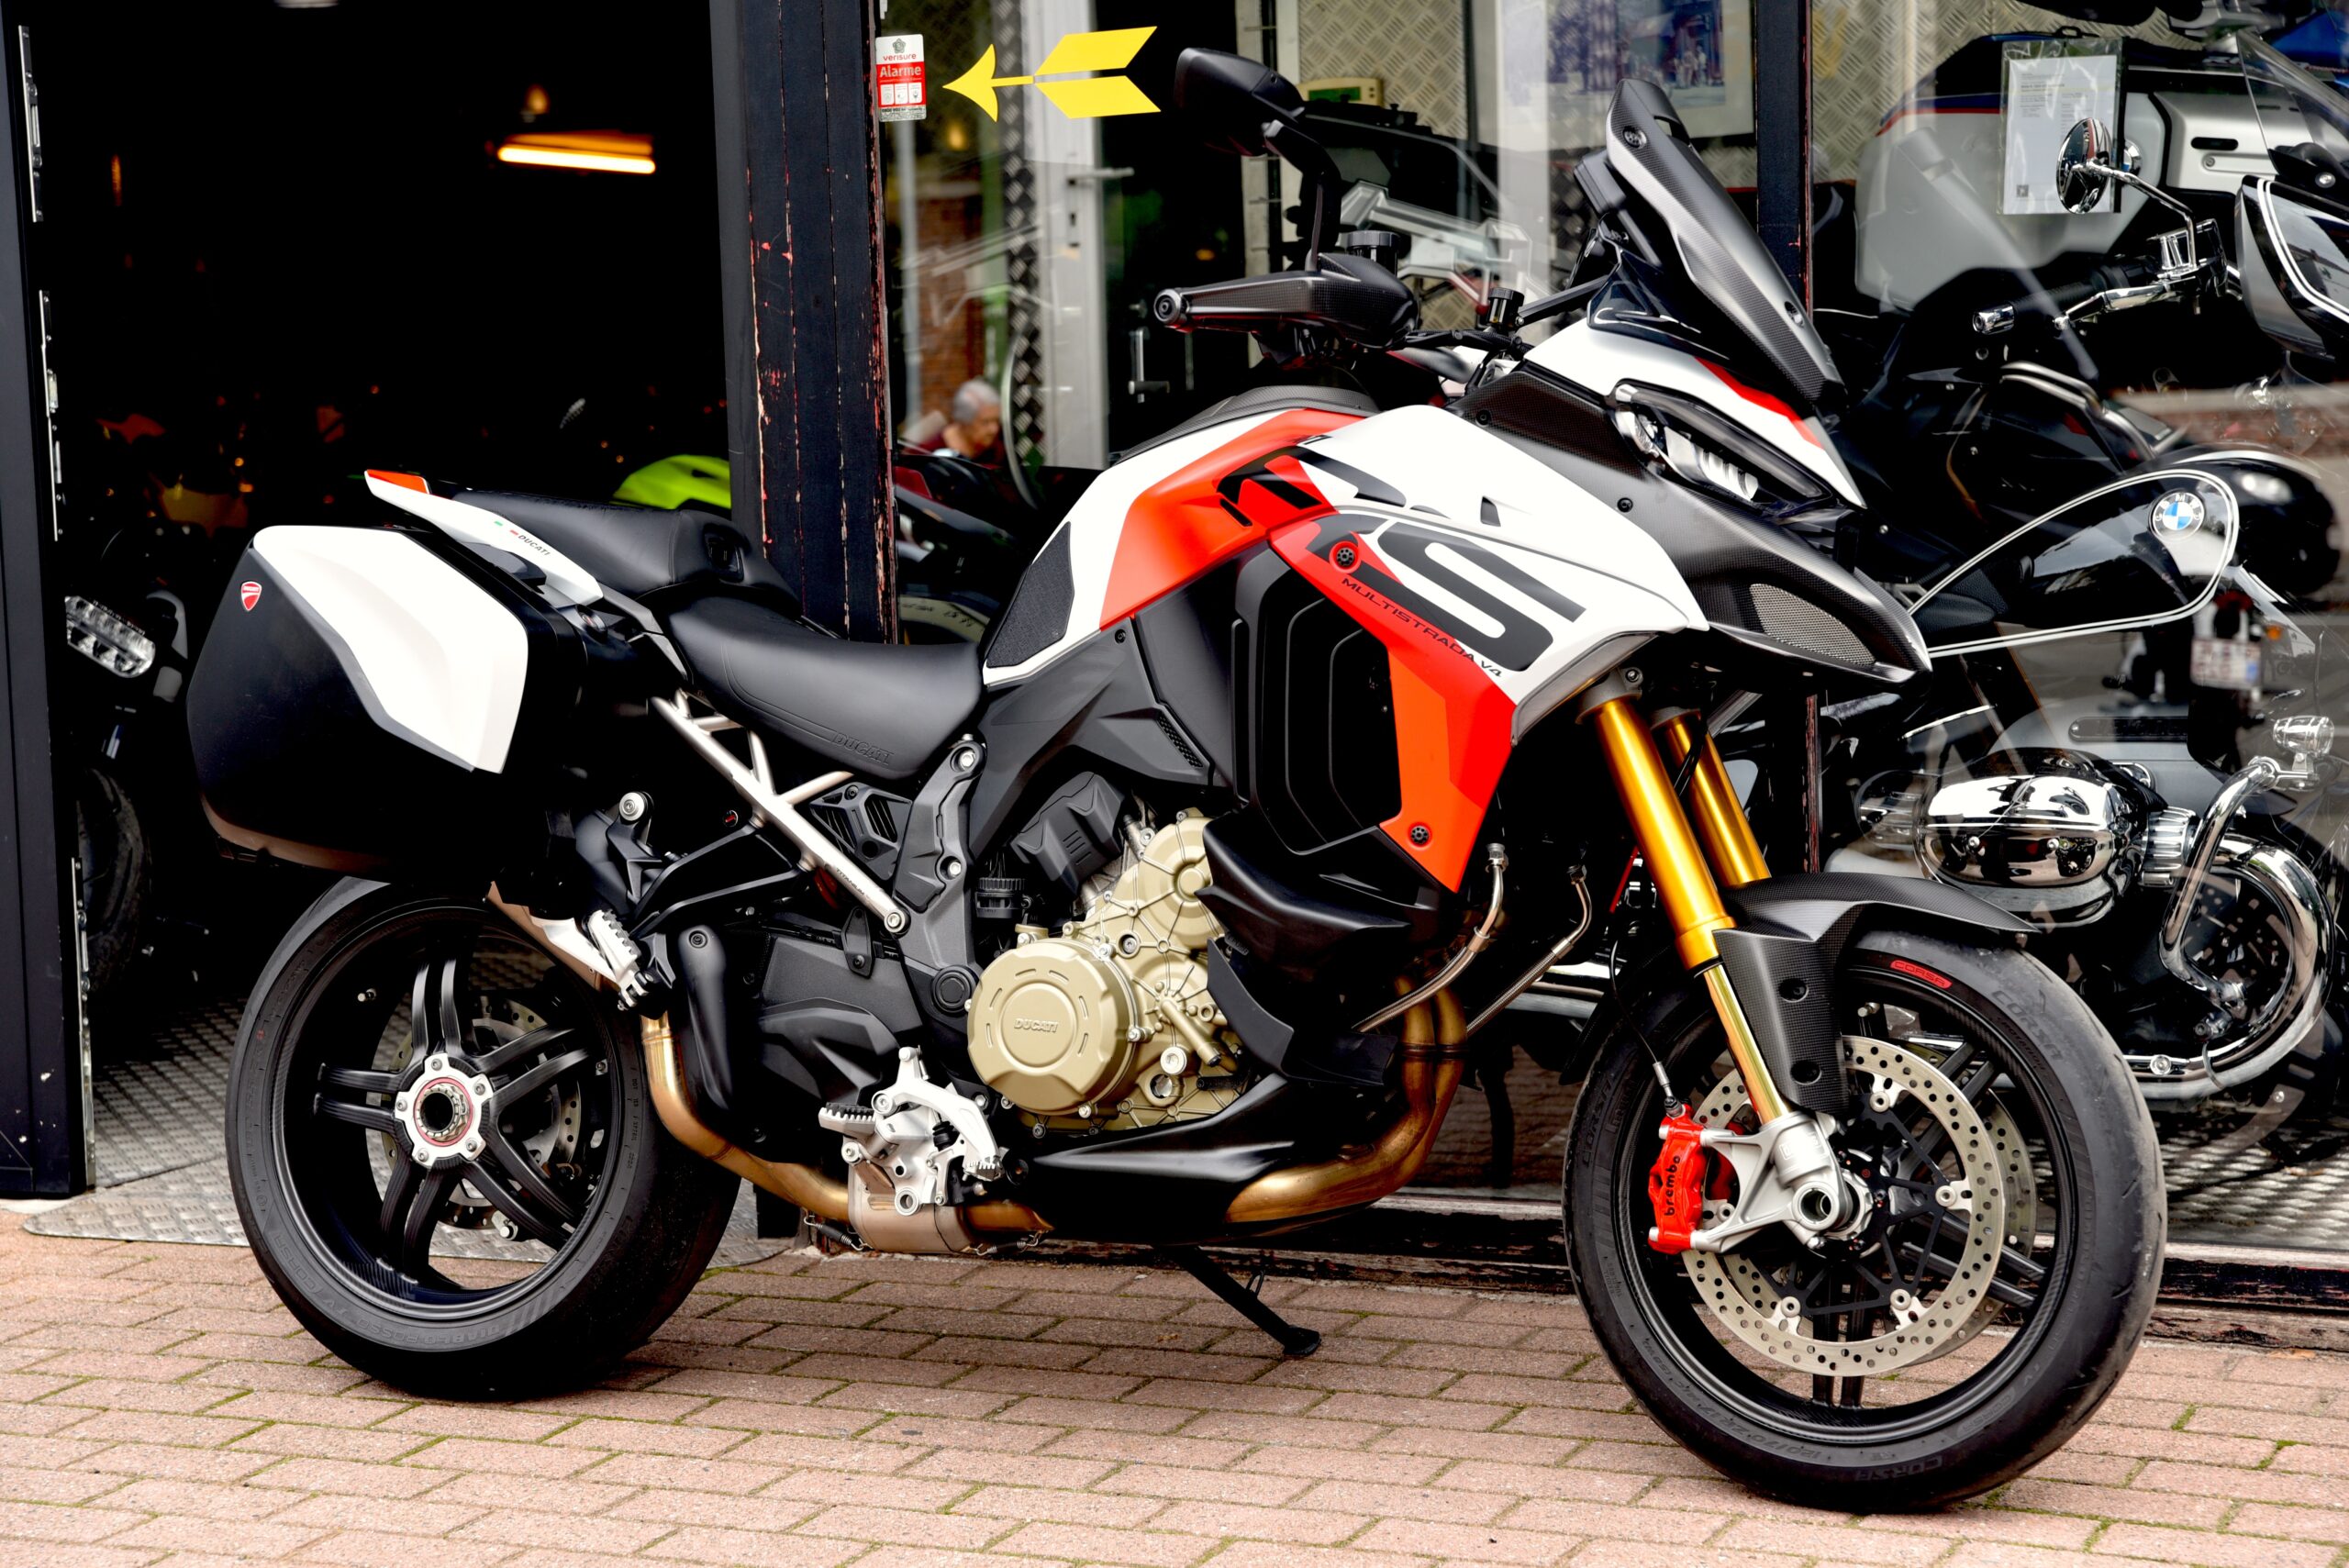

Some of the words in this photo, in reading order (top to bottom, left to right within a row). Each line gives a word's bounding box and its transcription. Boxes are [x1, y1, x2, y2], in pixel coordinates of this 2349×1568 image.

[883, 53, 917, 61] verisure
[880, 65, 921, 77] Alarme
[518, 534, 551, 556] DUCATI
[1341, 577, 1475, 663] MULTISTRADA
[1479, 660, 1502, 678] V4
[832, 733, 895, 766] DUCATI
[1894, 962, 1945, 987] CORSA
[1013, 1018, 1060, 1034] DUCATI
[1664, 1155, 1681, 1217] brembo
